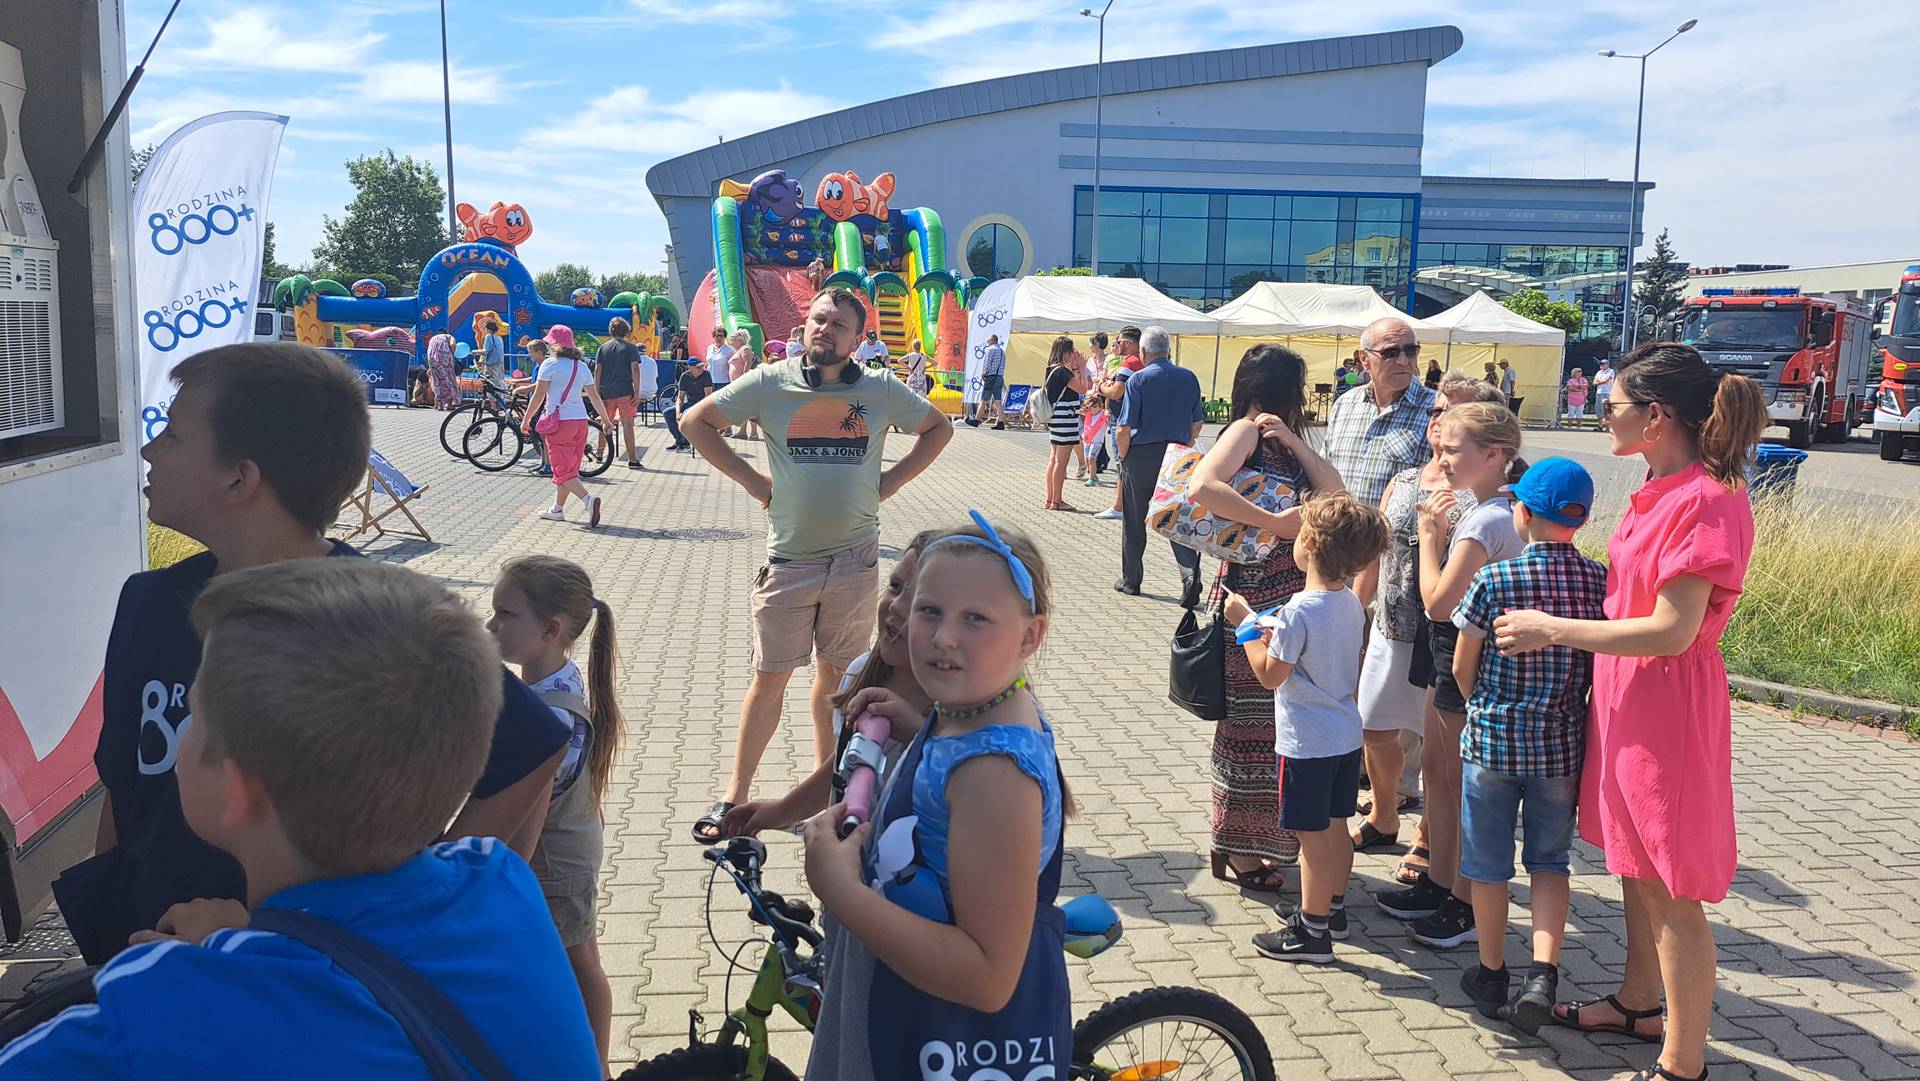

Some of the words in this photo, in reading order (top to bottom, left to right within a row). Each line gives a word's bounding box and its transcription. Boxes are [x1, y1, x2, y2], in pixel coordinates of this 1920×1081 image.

[166, 185, 247, 219] RODZINA
[148, 204, 255, 255] 800+
[441, 248, 511, 268] OCEAN
[161, 280, 239, 316] RODZINA
[143, 296, 248, 352] 800+
[978, 310, 1008, 328] 800+
[788, 447, 818, 456] JACK
[821, 447, 831, 456] &
[832, 447, 868, 457] JONES
